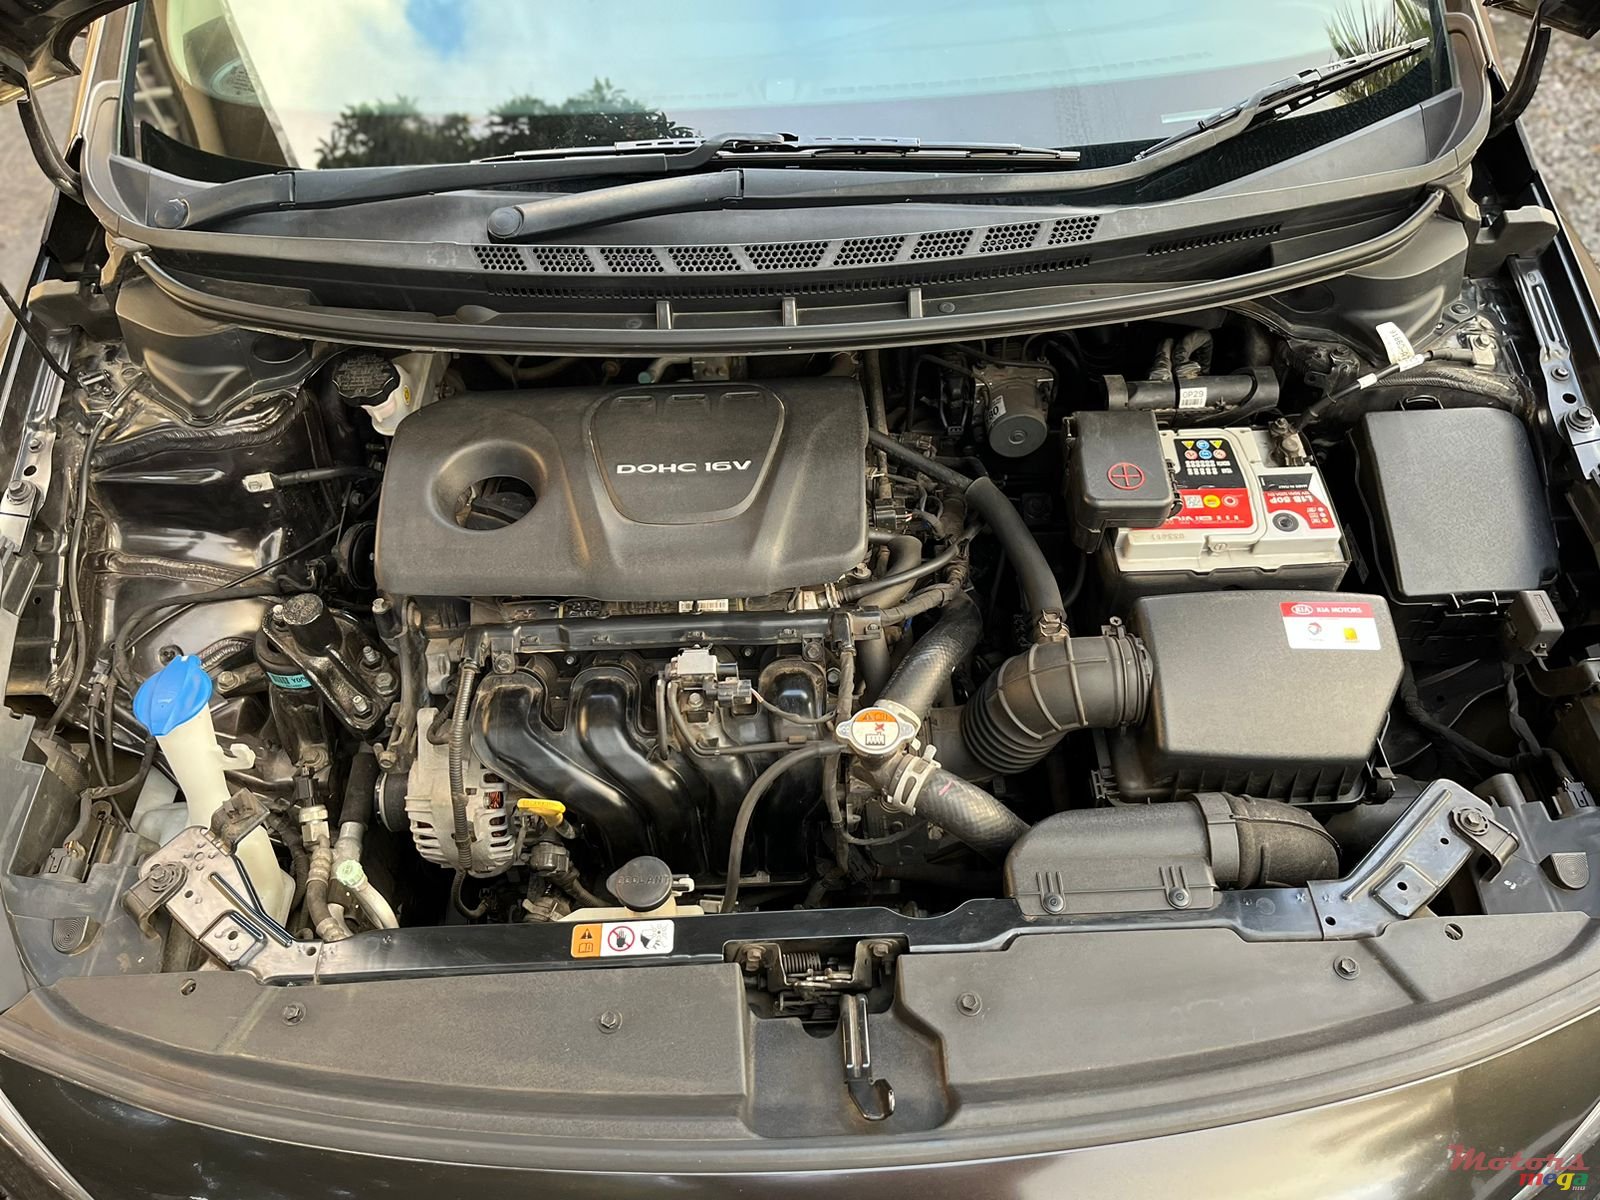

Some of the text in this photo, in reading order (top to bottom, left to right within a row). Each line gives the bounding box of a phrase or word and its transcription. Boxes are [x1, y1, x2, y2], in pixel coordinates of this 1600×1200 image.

[616, 460, 752, 474] DOHC 16V
[616, 873, 670, 886] COOLANT
